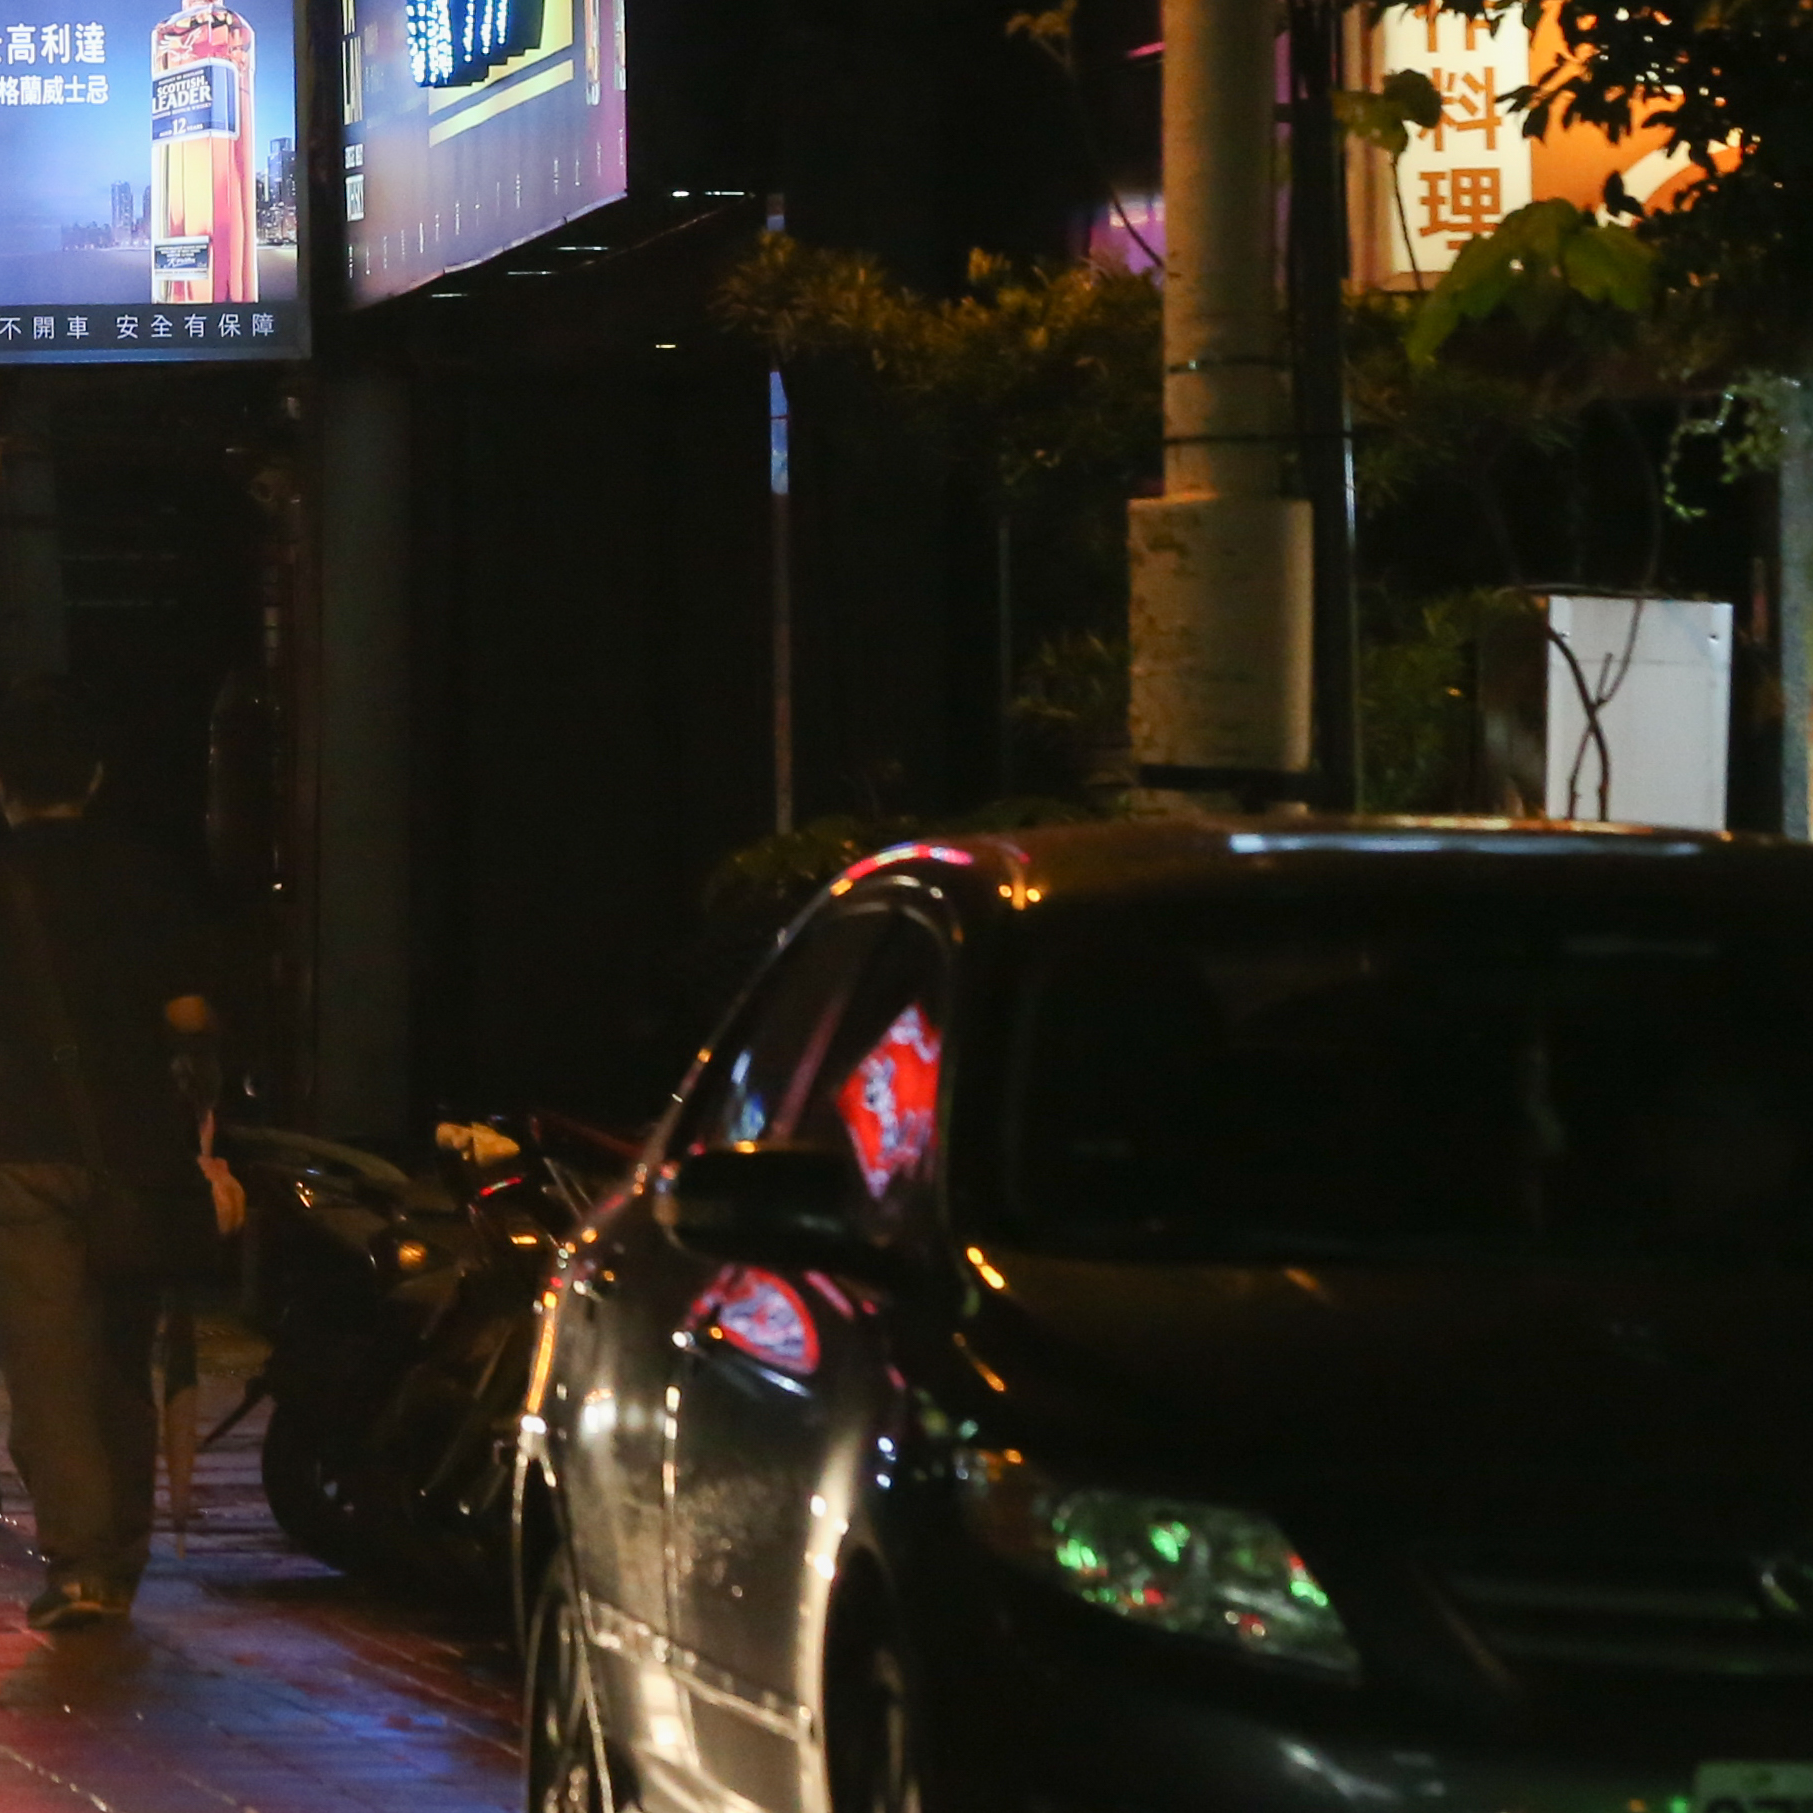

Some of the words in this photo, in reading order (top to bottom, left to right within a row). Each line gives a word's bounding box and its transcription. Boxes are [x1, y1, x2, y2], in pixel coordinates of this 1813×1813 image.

[171, 117, 187, 135] 12
[116, 312, 276, 339] 安全有保障
